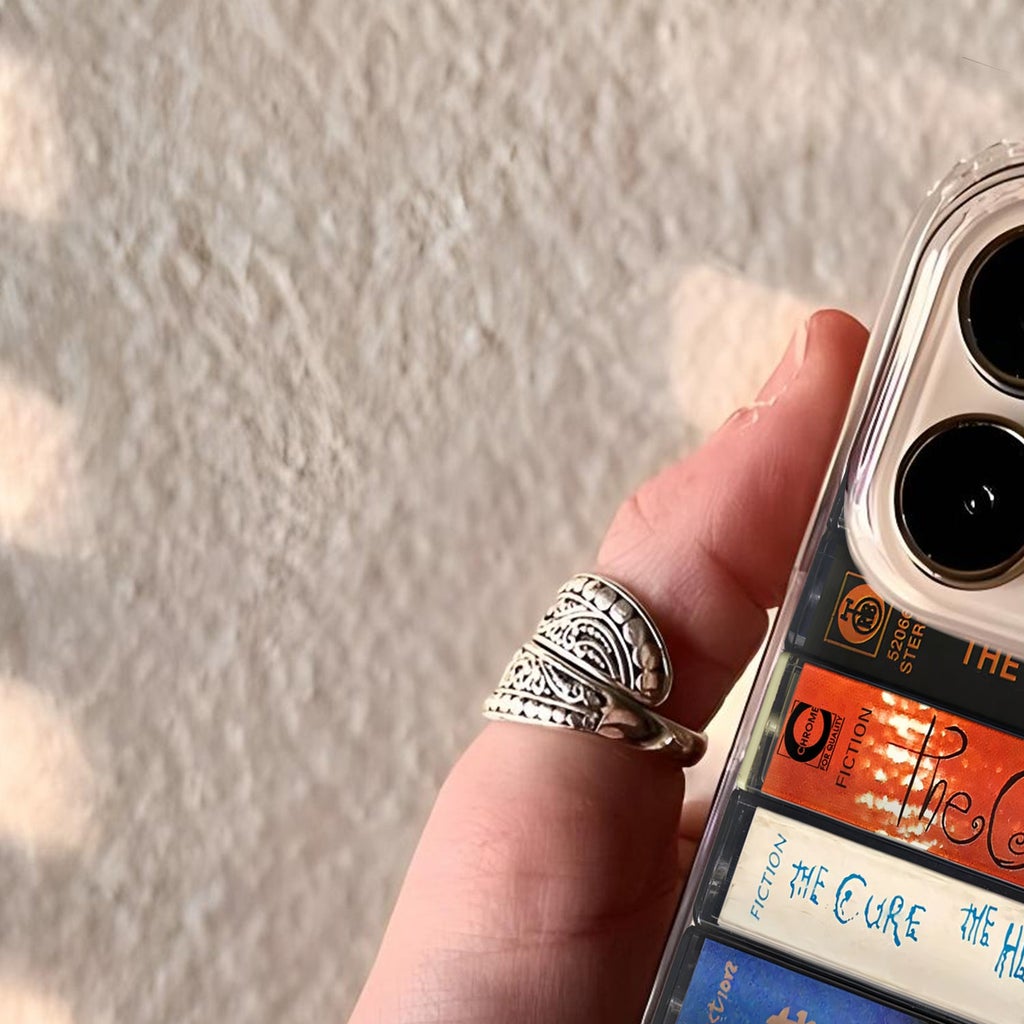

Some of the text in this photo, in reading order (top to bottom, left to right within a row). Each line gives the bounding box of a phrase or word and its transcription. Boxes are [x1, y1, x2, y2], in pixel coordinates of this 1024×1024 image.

[797, 706, 819, 755] CHROME
[820, 715, 843, 771] FOR QUALITY
[835, 707, 872, 788] FICTION
[888, 715, 985, 844] The
[750, 833, 787, 920] FICTION
